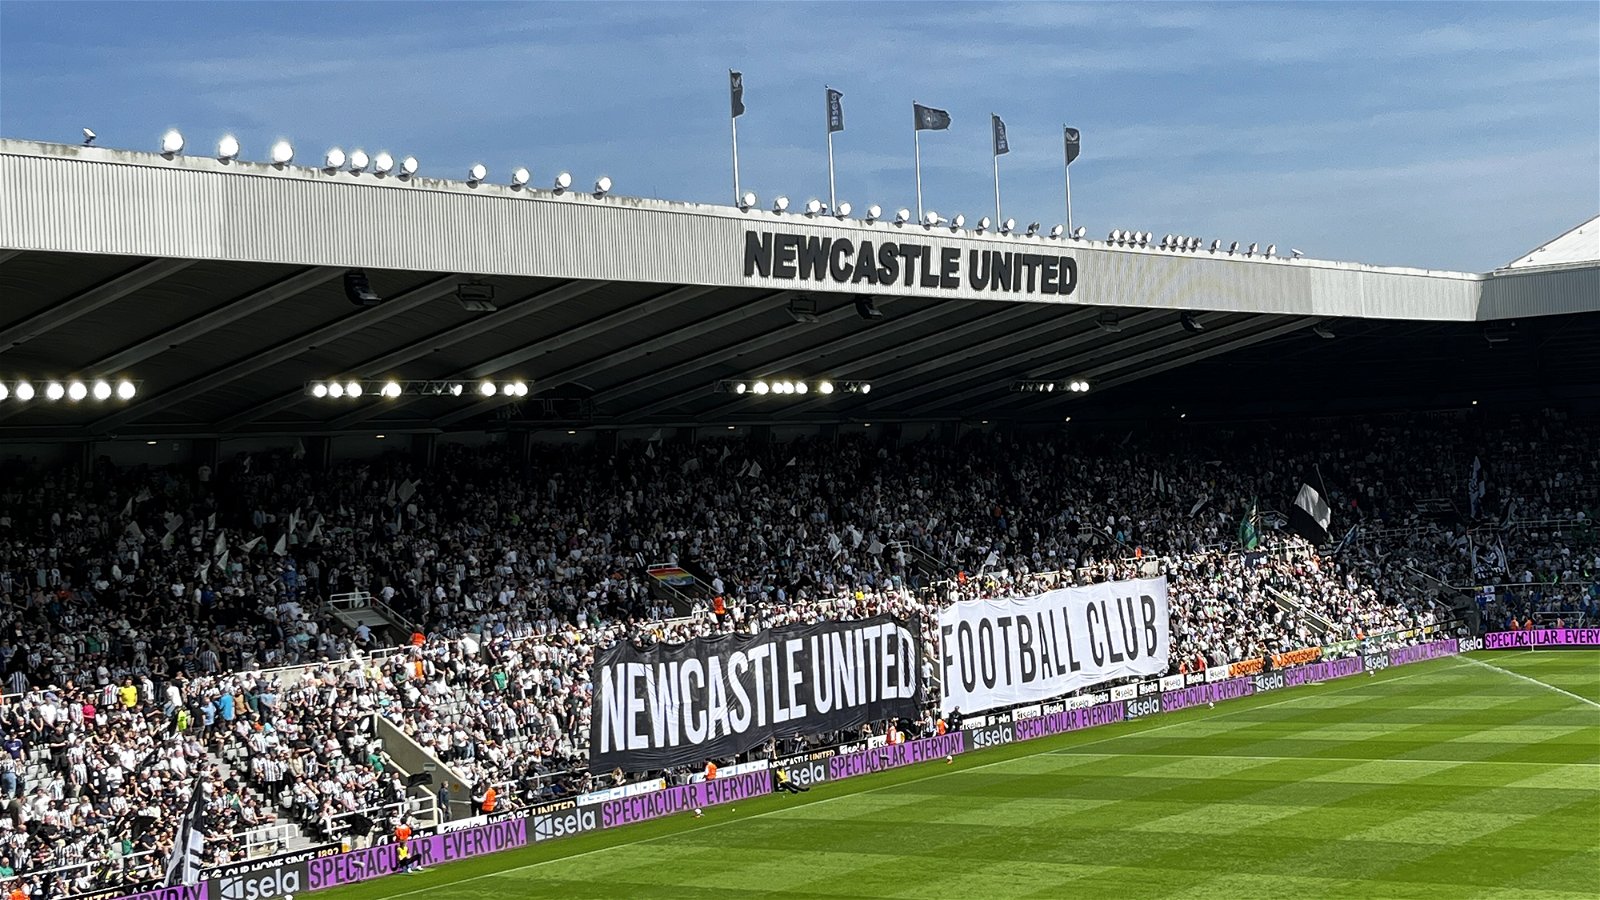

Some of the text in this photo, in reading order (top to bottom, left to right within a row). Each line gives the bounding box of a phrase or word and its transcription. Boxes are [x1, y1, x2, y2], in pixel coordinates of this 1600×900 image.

[744, 230, 1077, 295] NEWCASTLE UNITED
[941, 594, 1157, 697] FOOTBALL CLUB
[1466, 636, 1483, 650] sela
[1373, 653, 1388, 669] sela
[600, 622, 916, 753] NEWCASTLE UNITED
[1121, 688, 1133, 698] sela
[1264, 673, 1283, 691] sela
[1050, 703, 1064, 713] sela
[1138, 697, 1159, 716] sela
[985, 725, 1012, 747] sela
[1016, 711, 1080, 740] SPECTACULAR.
[770, 749, 835, 769] NEWCASTLE UNITED
[912, 735, 963, 762] EVERYDAY.
[792, 762, 825, 786] sela
[532, 800, 576, 816] UNITED
[604, 785, 703, 827] SPECTACULAR.
[707, 770, 771, 804] EVERYDAY.
[554, 808, 596, 838] sela
[310, 820, 525, 889] SPECTACUAR. EVERYDAY.
[246, 868, 299, 900] sela
